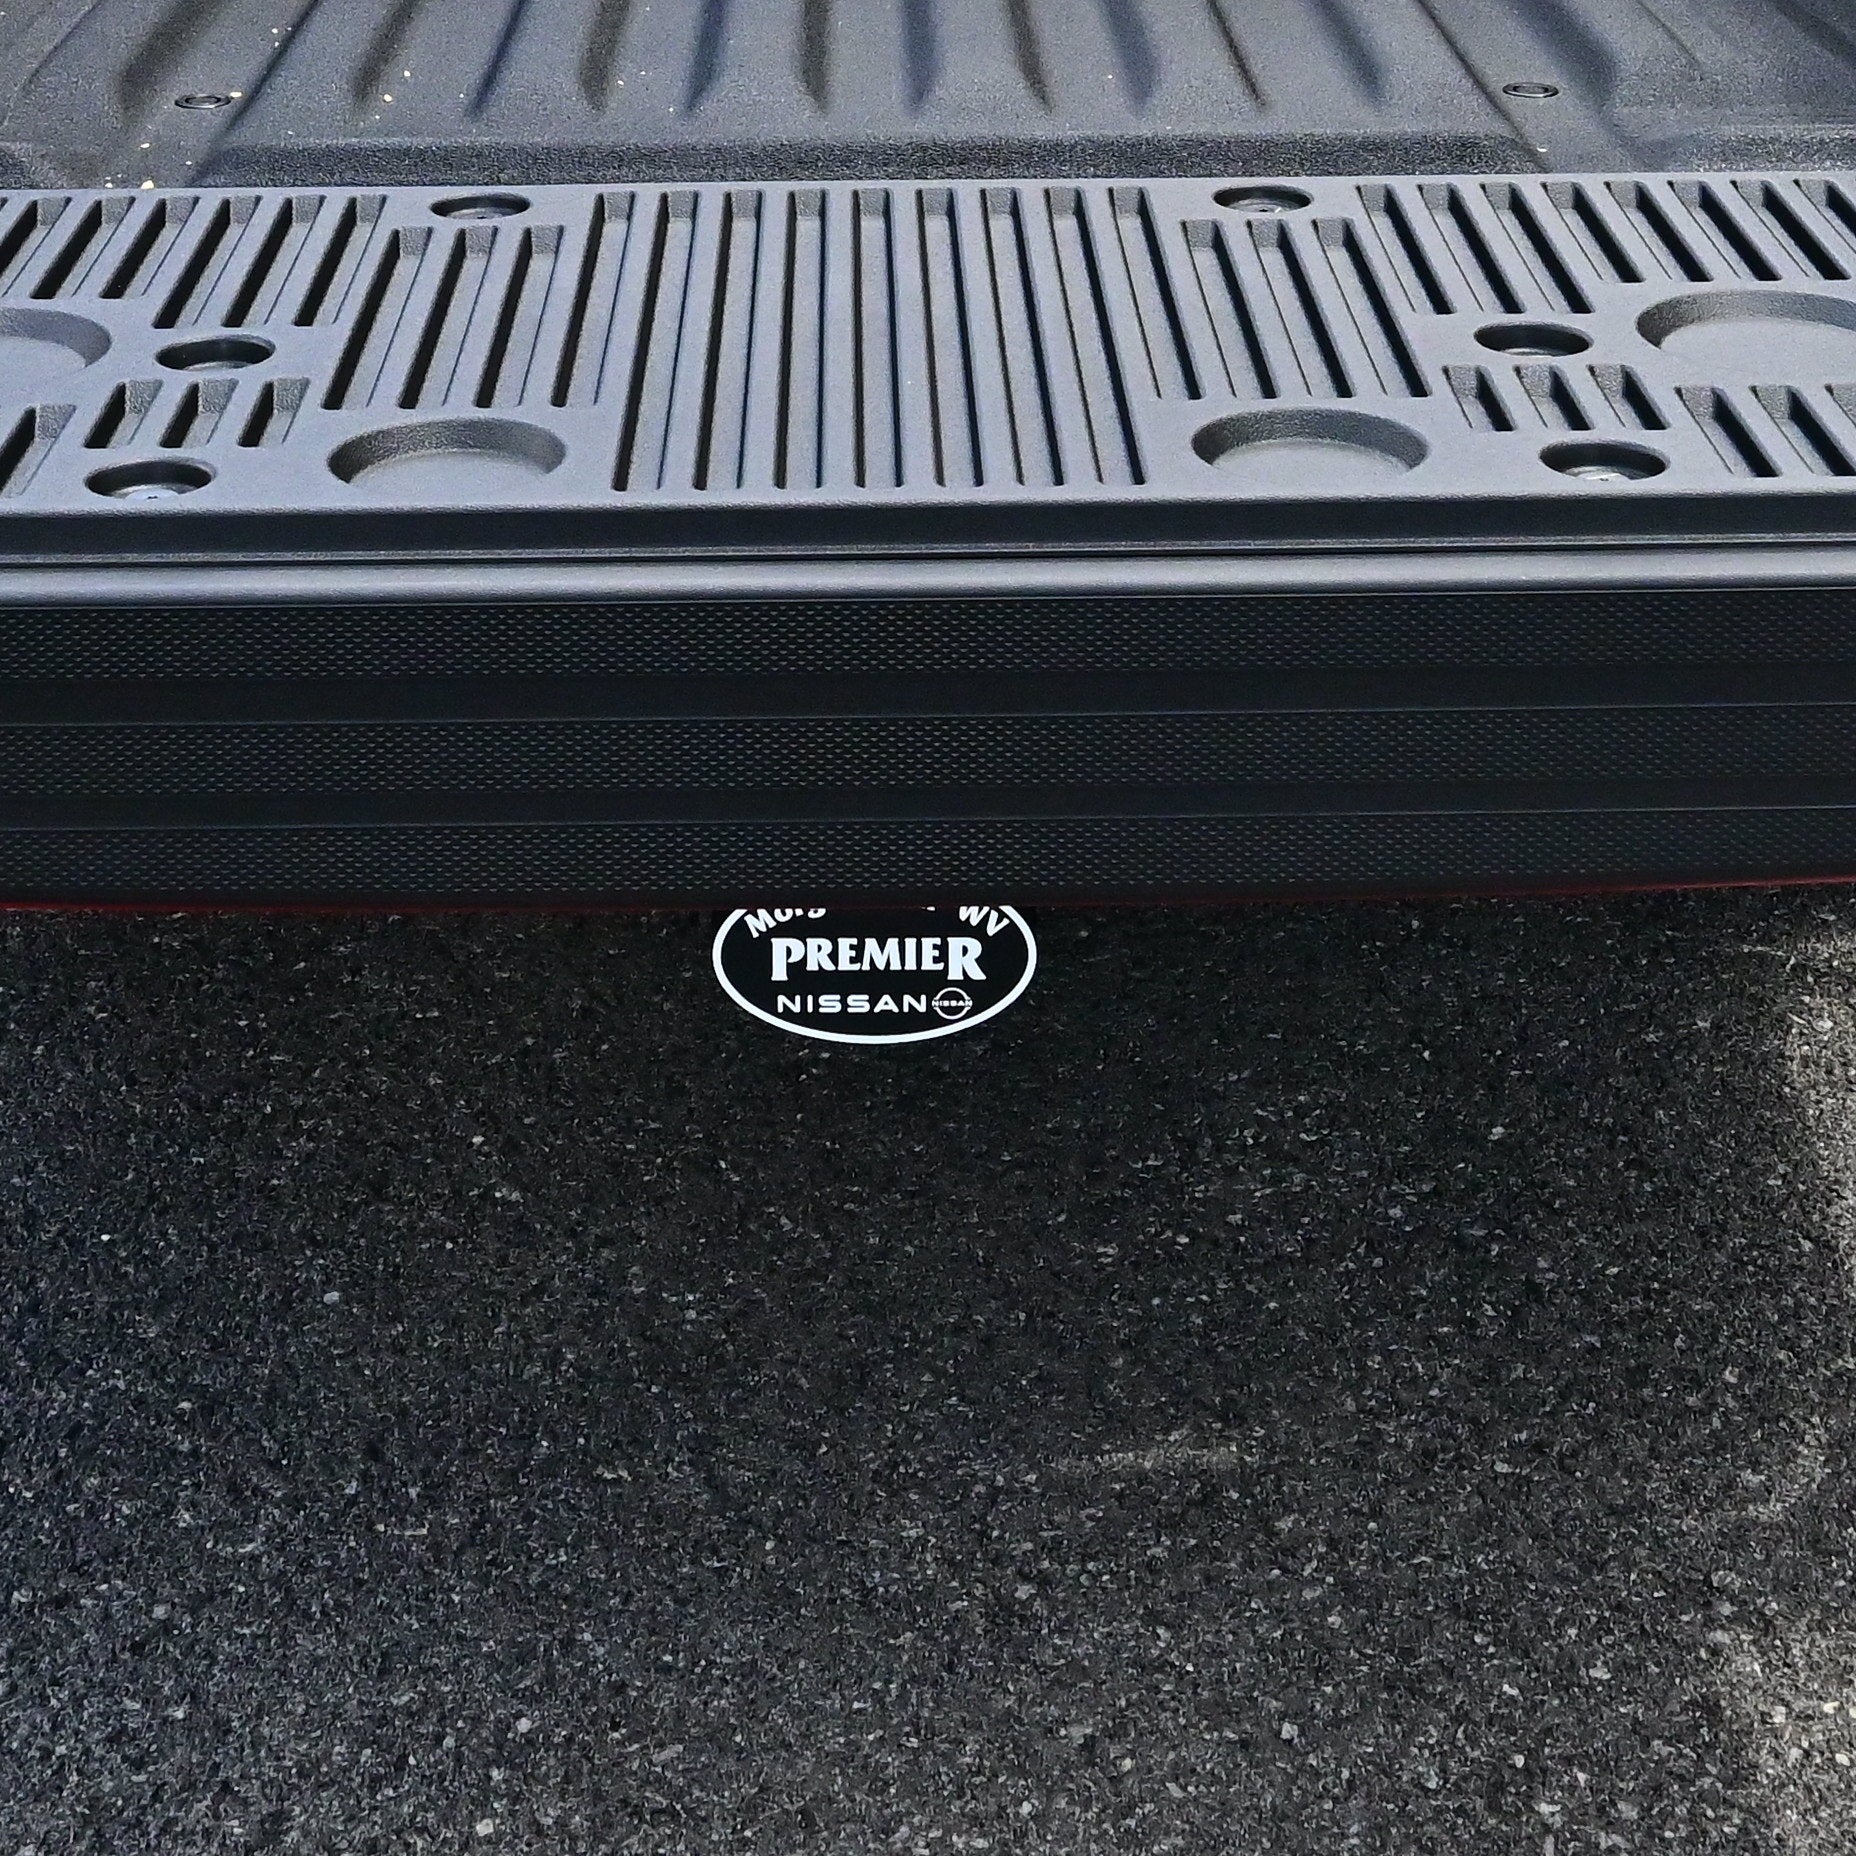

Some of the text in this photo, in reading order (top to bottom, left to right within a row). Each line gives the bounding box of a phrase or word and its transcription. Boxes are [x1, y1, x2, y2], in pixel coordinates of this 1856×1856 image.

[958, 906, 1010, 937] WV
[770, 937, 987, 981] PREMIER
[777, 994, 927, 1013] NISSAN
